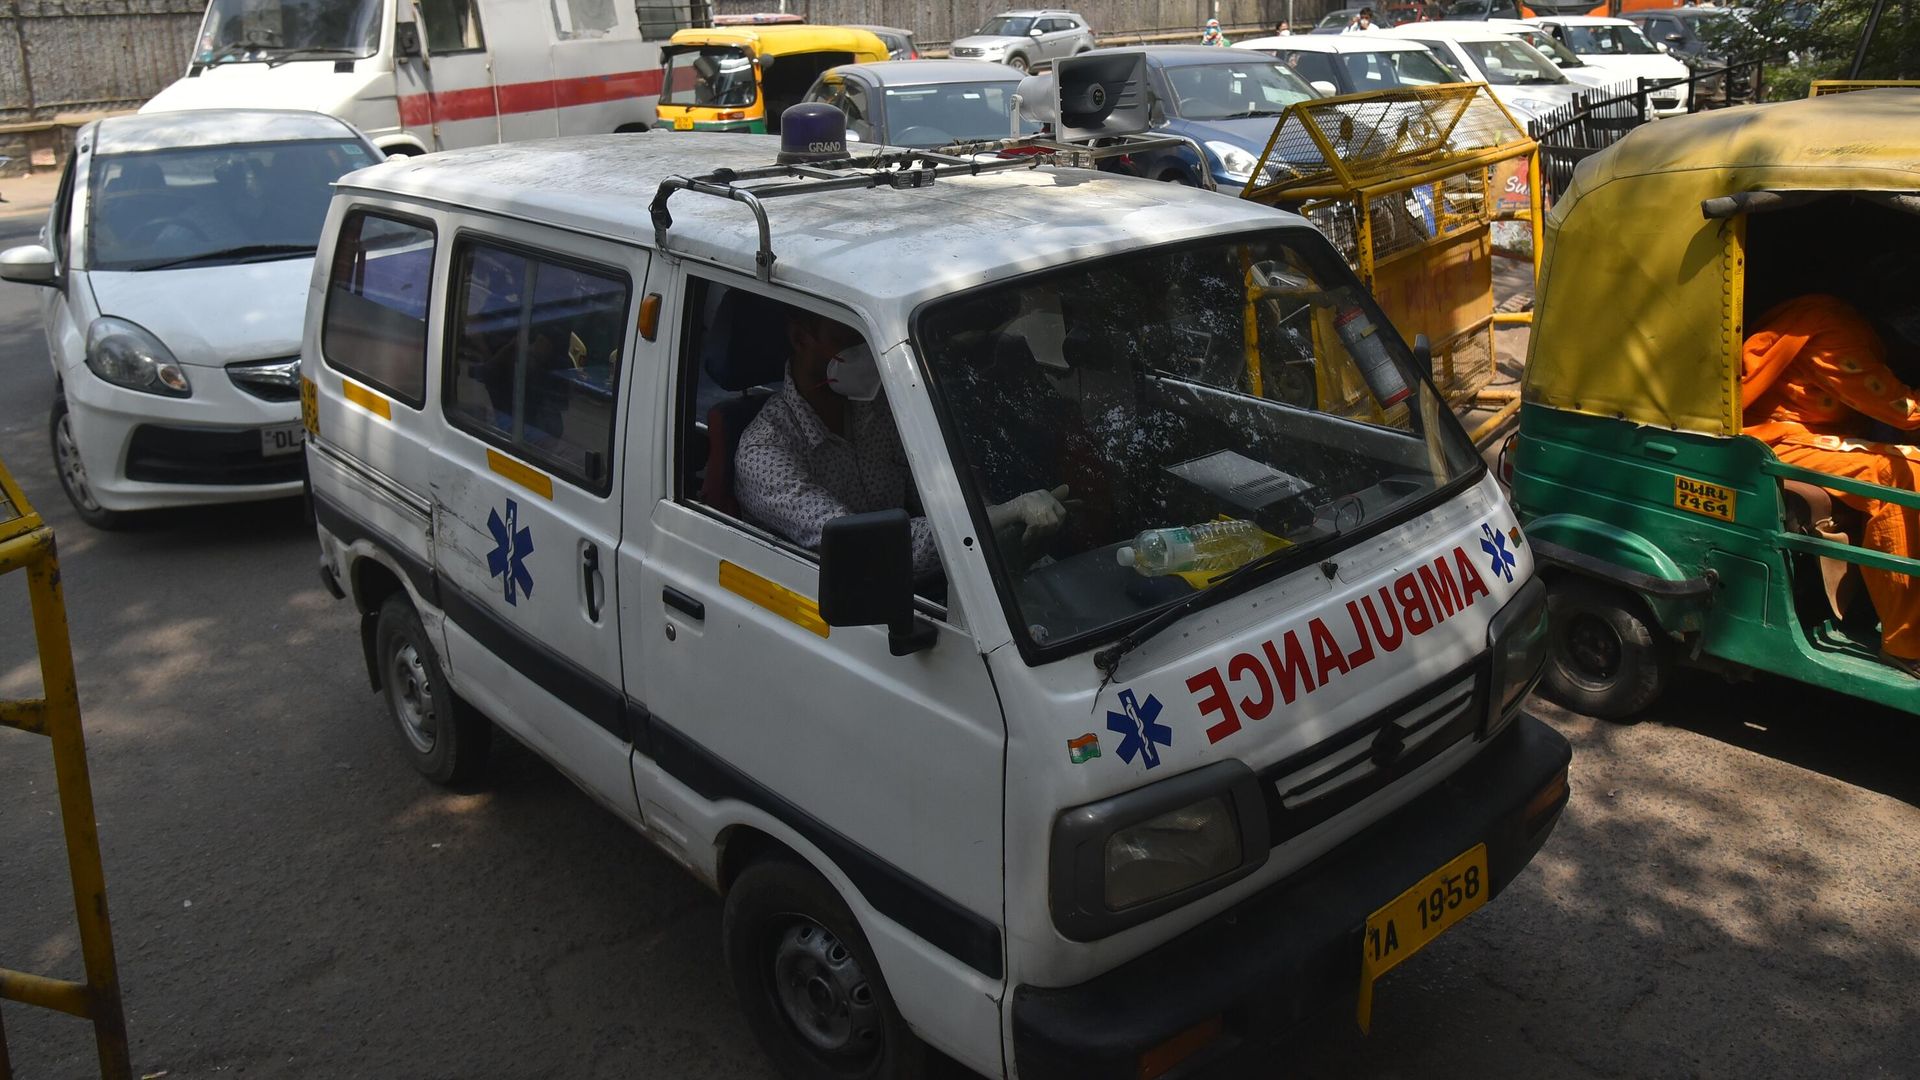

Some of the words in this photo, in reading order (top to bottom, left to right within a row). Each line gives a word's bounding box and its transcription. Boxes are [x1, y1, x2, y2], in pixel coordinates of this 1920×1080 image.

[809, 141, 841, 152] GRAND
[1680, 494, 1729, 516] 7464
[1417, 865, 1480, 930] 1958
